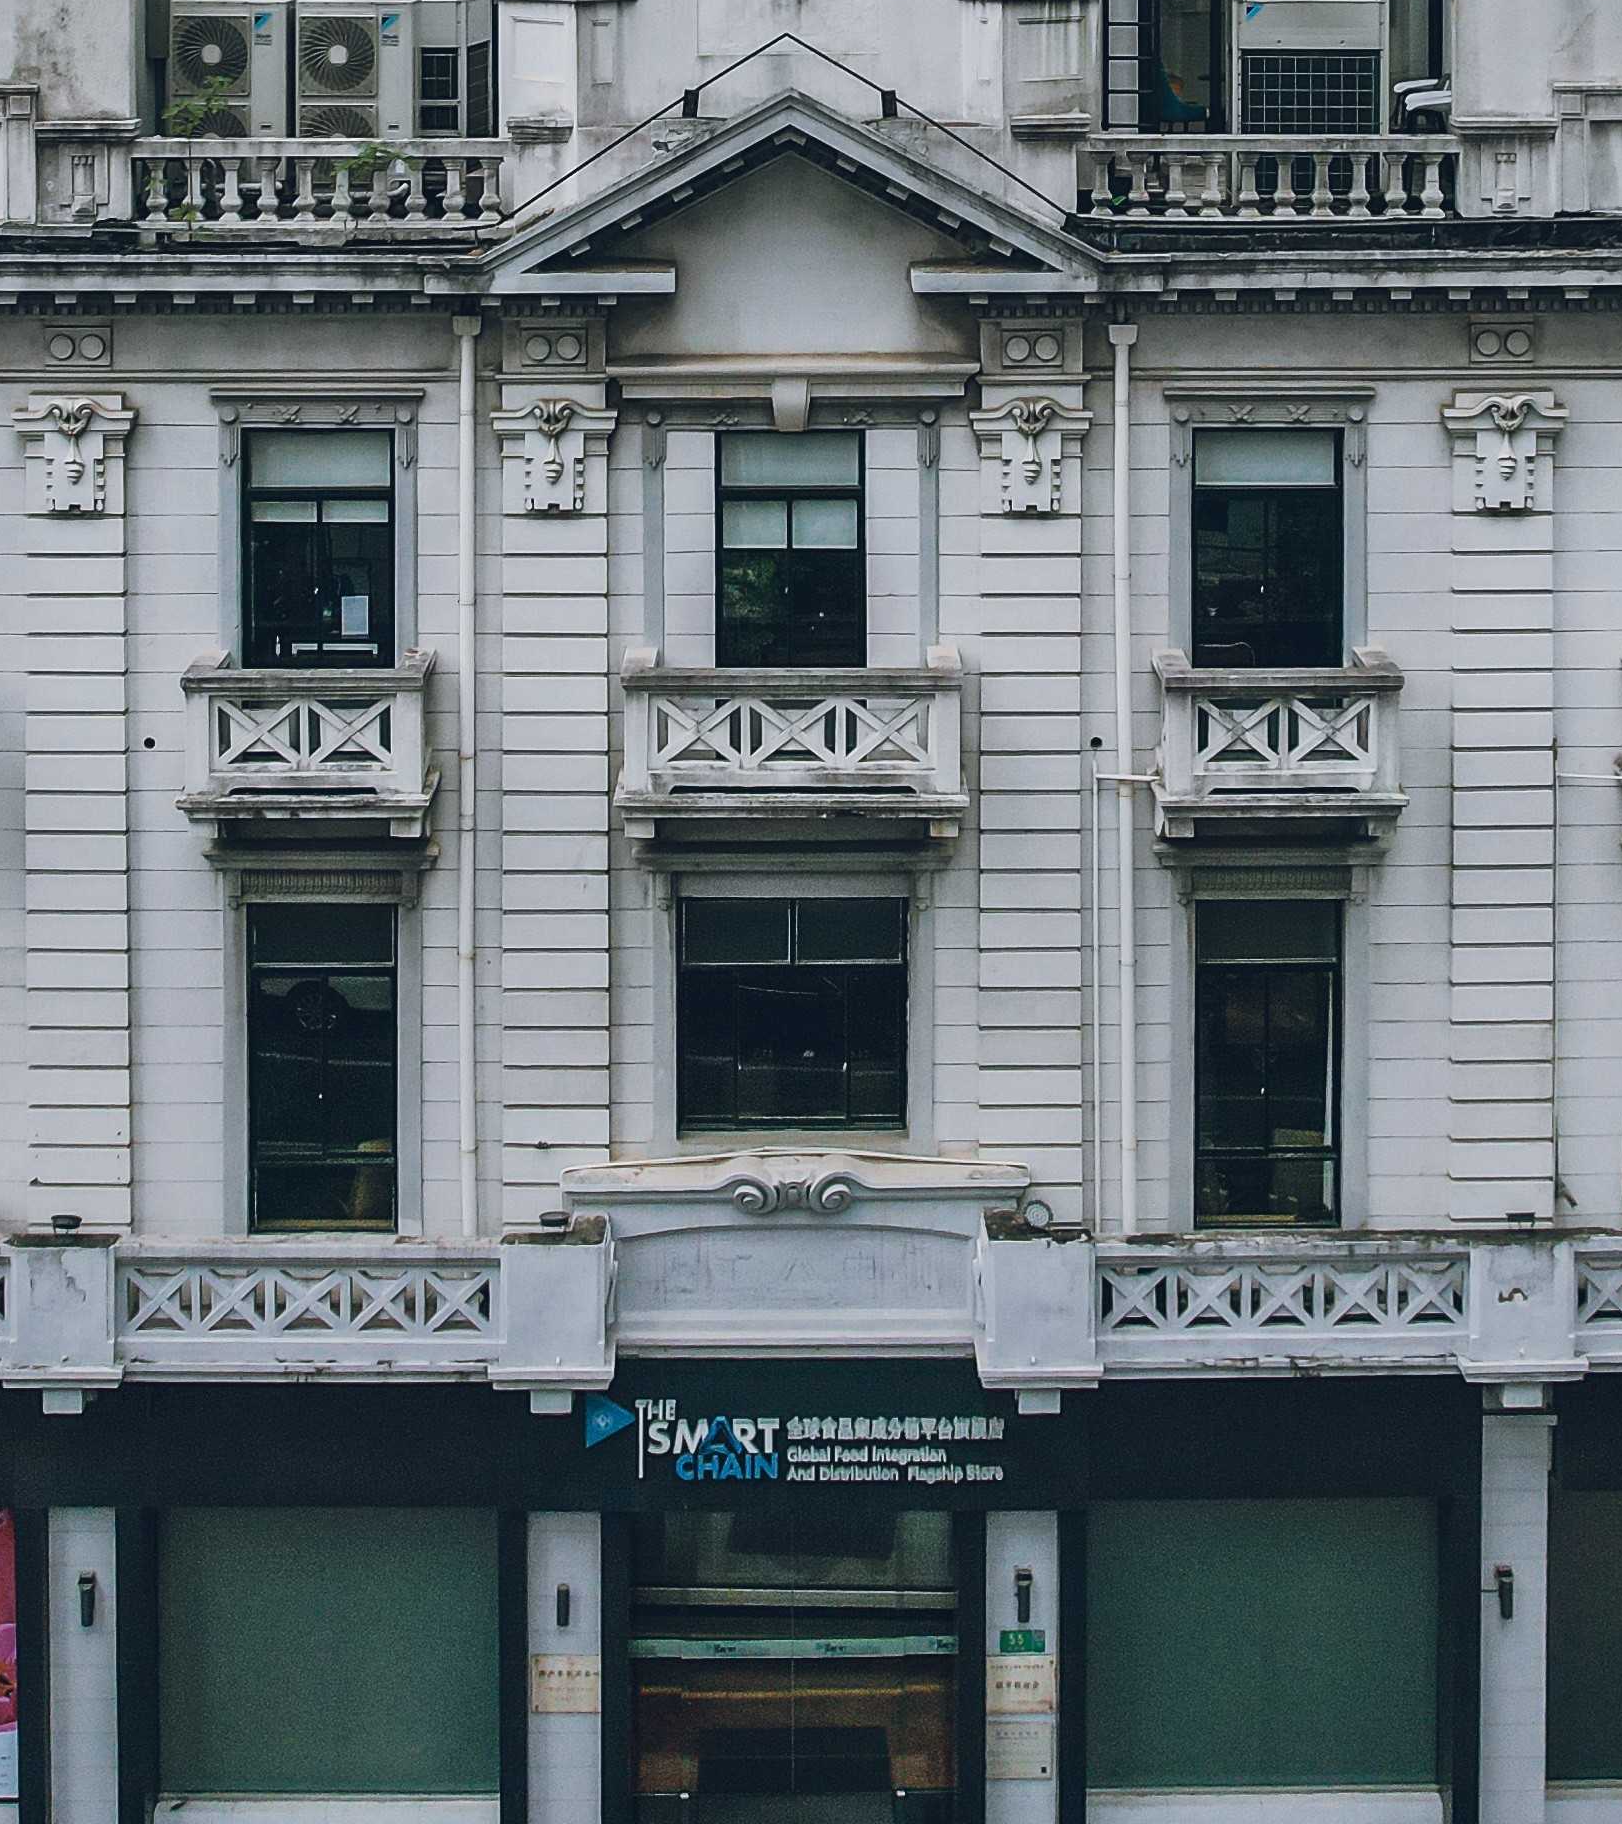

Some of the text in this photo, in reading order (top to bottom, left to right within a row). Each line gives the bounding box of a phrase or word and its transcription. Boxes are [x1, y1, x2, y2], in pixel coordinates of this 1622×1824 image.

[647, 1416, 779, 1455] SMART
[675, 1452, 779, 1481] CHAIN
[787, 1445, 947, 1465] Global Food Integration
[787, 1464, 1004, 1484] And Distribution Flagship Store
